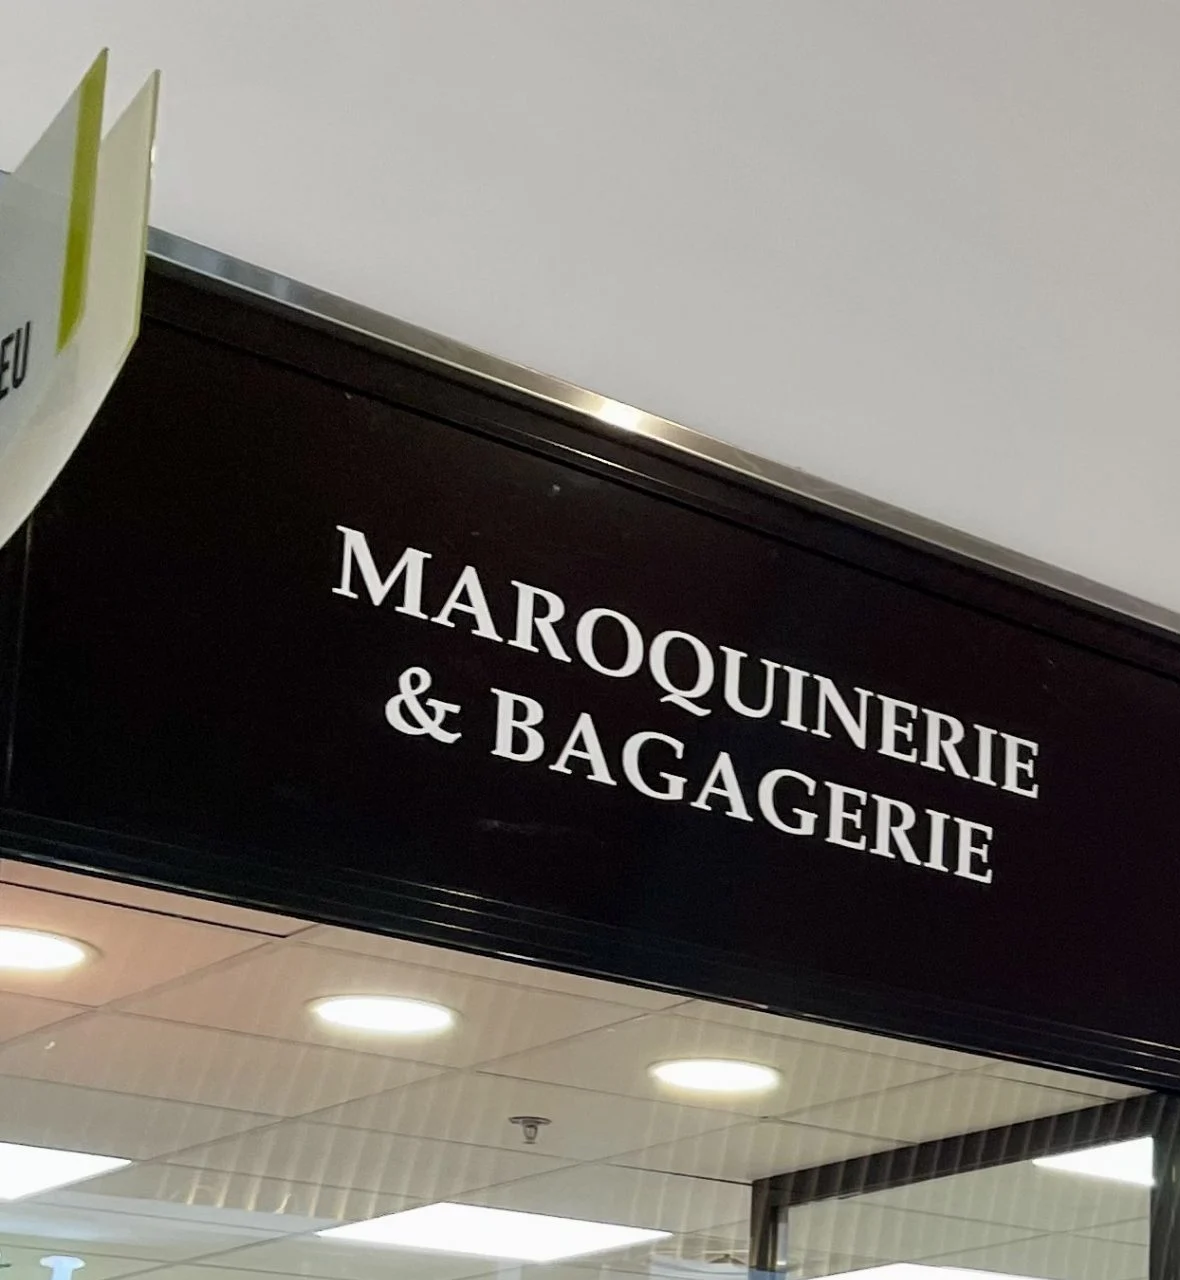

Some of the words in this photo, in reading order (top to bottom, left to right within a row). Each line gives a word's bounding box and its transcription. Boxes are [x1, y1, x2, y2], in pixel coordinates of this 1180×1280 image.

[331, 525, 1041, 802] MAROQUINERIE
[384, 666, 462, 745] &
[490, 687, 996, 886] BAGAGERIE
